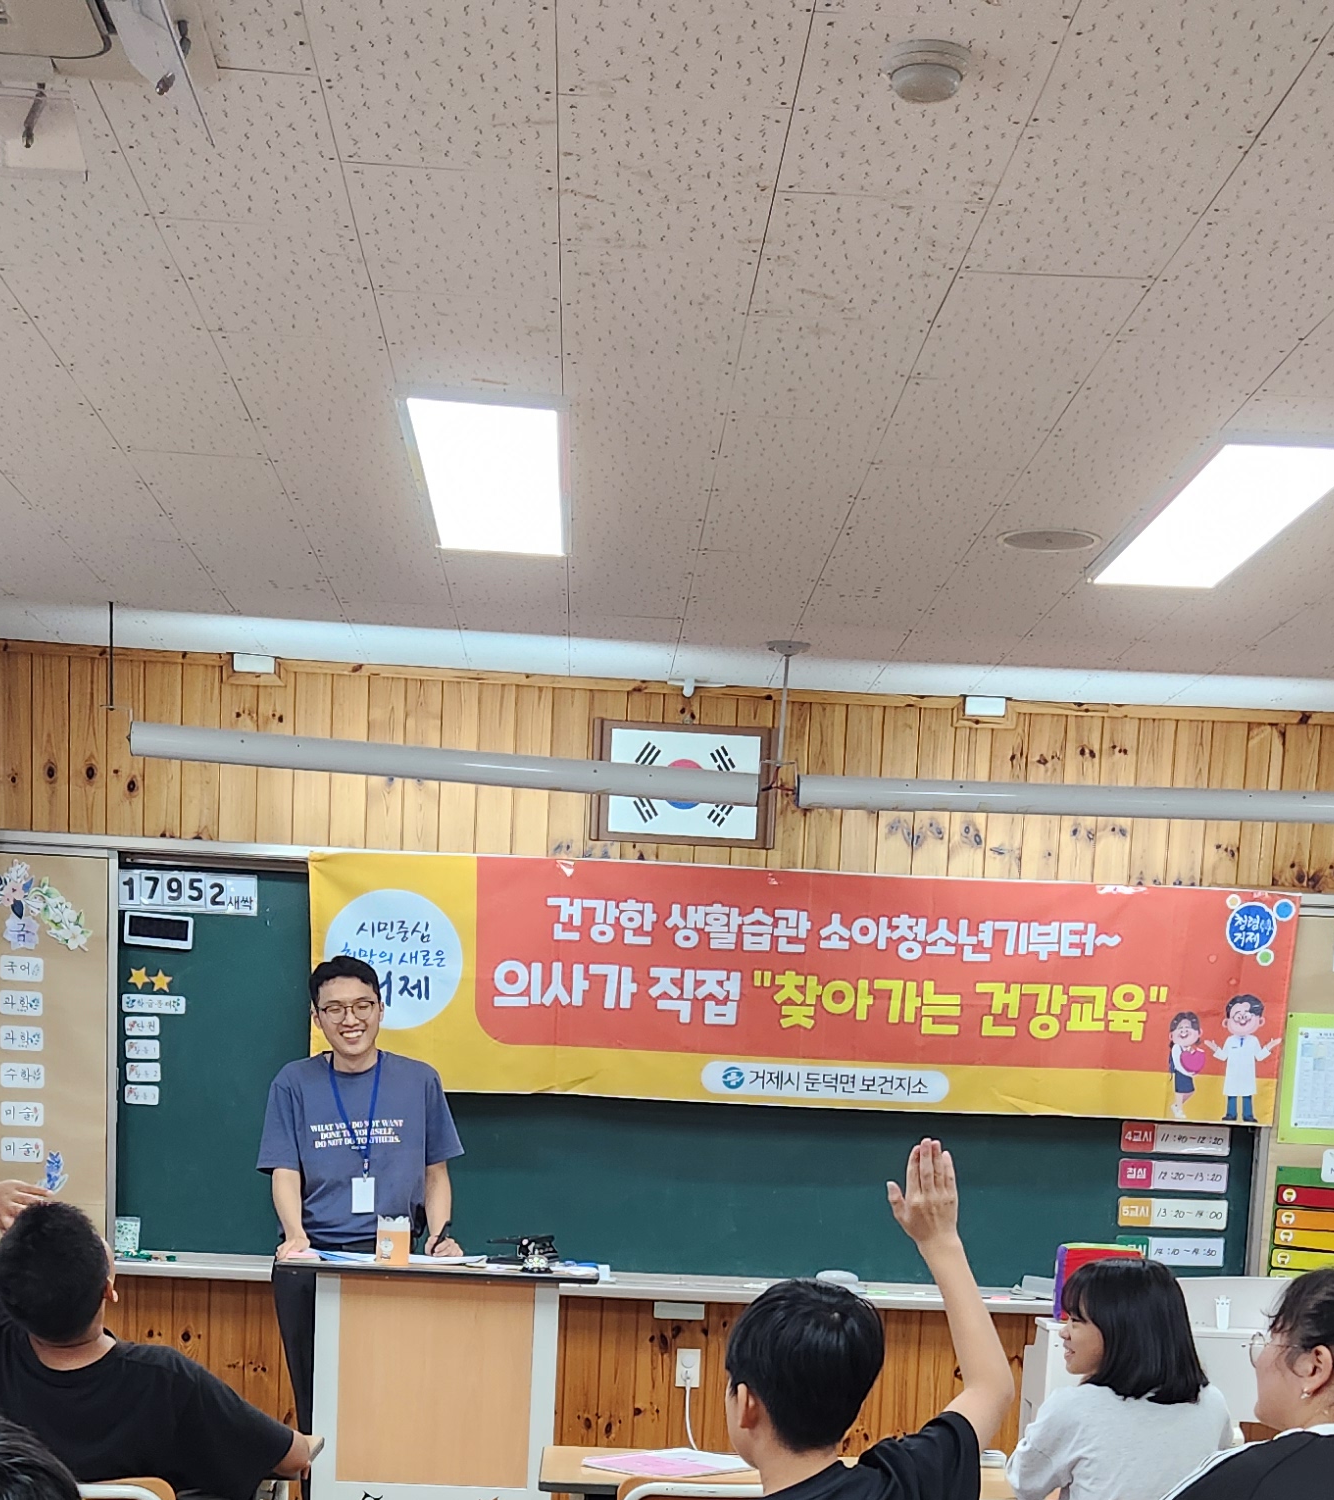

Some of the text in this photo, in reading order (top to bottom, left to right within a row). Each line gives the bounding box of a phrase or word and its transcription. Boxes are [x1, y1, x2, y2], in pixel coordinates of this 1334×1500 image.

[122, 876, 226, 906] 17952
[10, 922, 36, 943] 금
[356, 920, 431, 943] 시민중심
[547, 897, 1122, 962] 건강한 생활습관 소아청소년기부터~
[398, 950, 446, 967] 새로운
[4, 961, 31, 976] 국어
[3, 994, 30, 1010] 과학
[493, 960, 1168, 1041] 의사가 직접 "찾아가는 건강교육"
[4, 1031, 30, 1046] 과학
[3, 1067, 32, 1082] 수학
[748, 1069, 929, 1096] 거제시 둔덕면 보건지소
[4, 1107, 33, 1121] 미술
[310, 1123, 334, 1132] WHAT
[352, 1121, 363, 1129] DO
[381, 1119, 404, 1127] WANT
[314, 1140, 327, 1148] DO
[327, 1138, 343, 1146] NOT
[356, 1136, 367, 1144] TO
[320, 1131, 341, 1140] DONE
[1124, 1130, 1152, 1142] 4교시
[4, 1143, 33, 1158] 미술
[1122, 1205, 1149, 1217] 5교시
